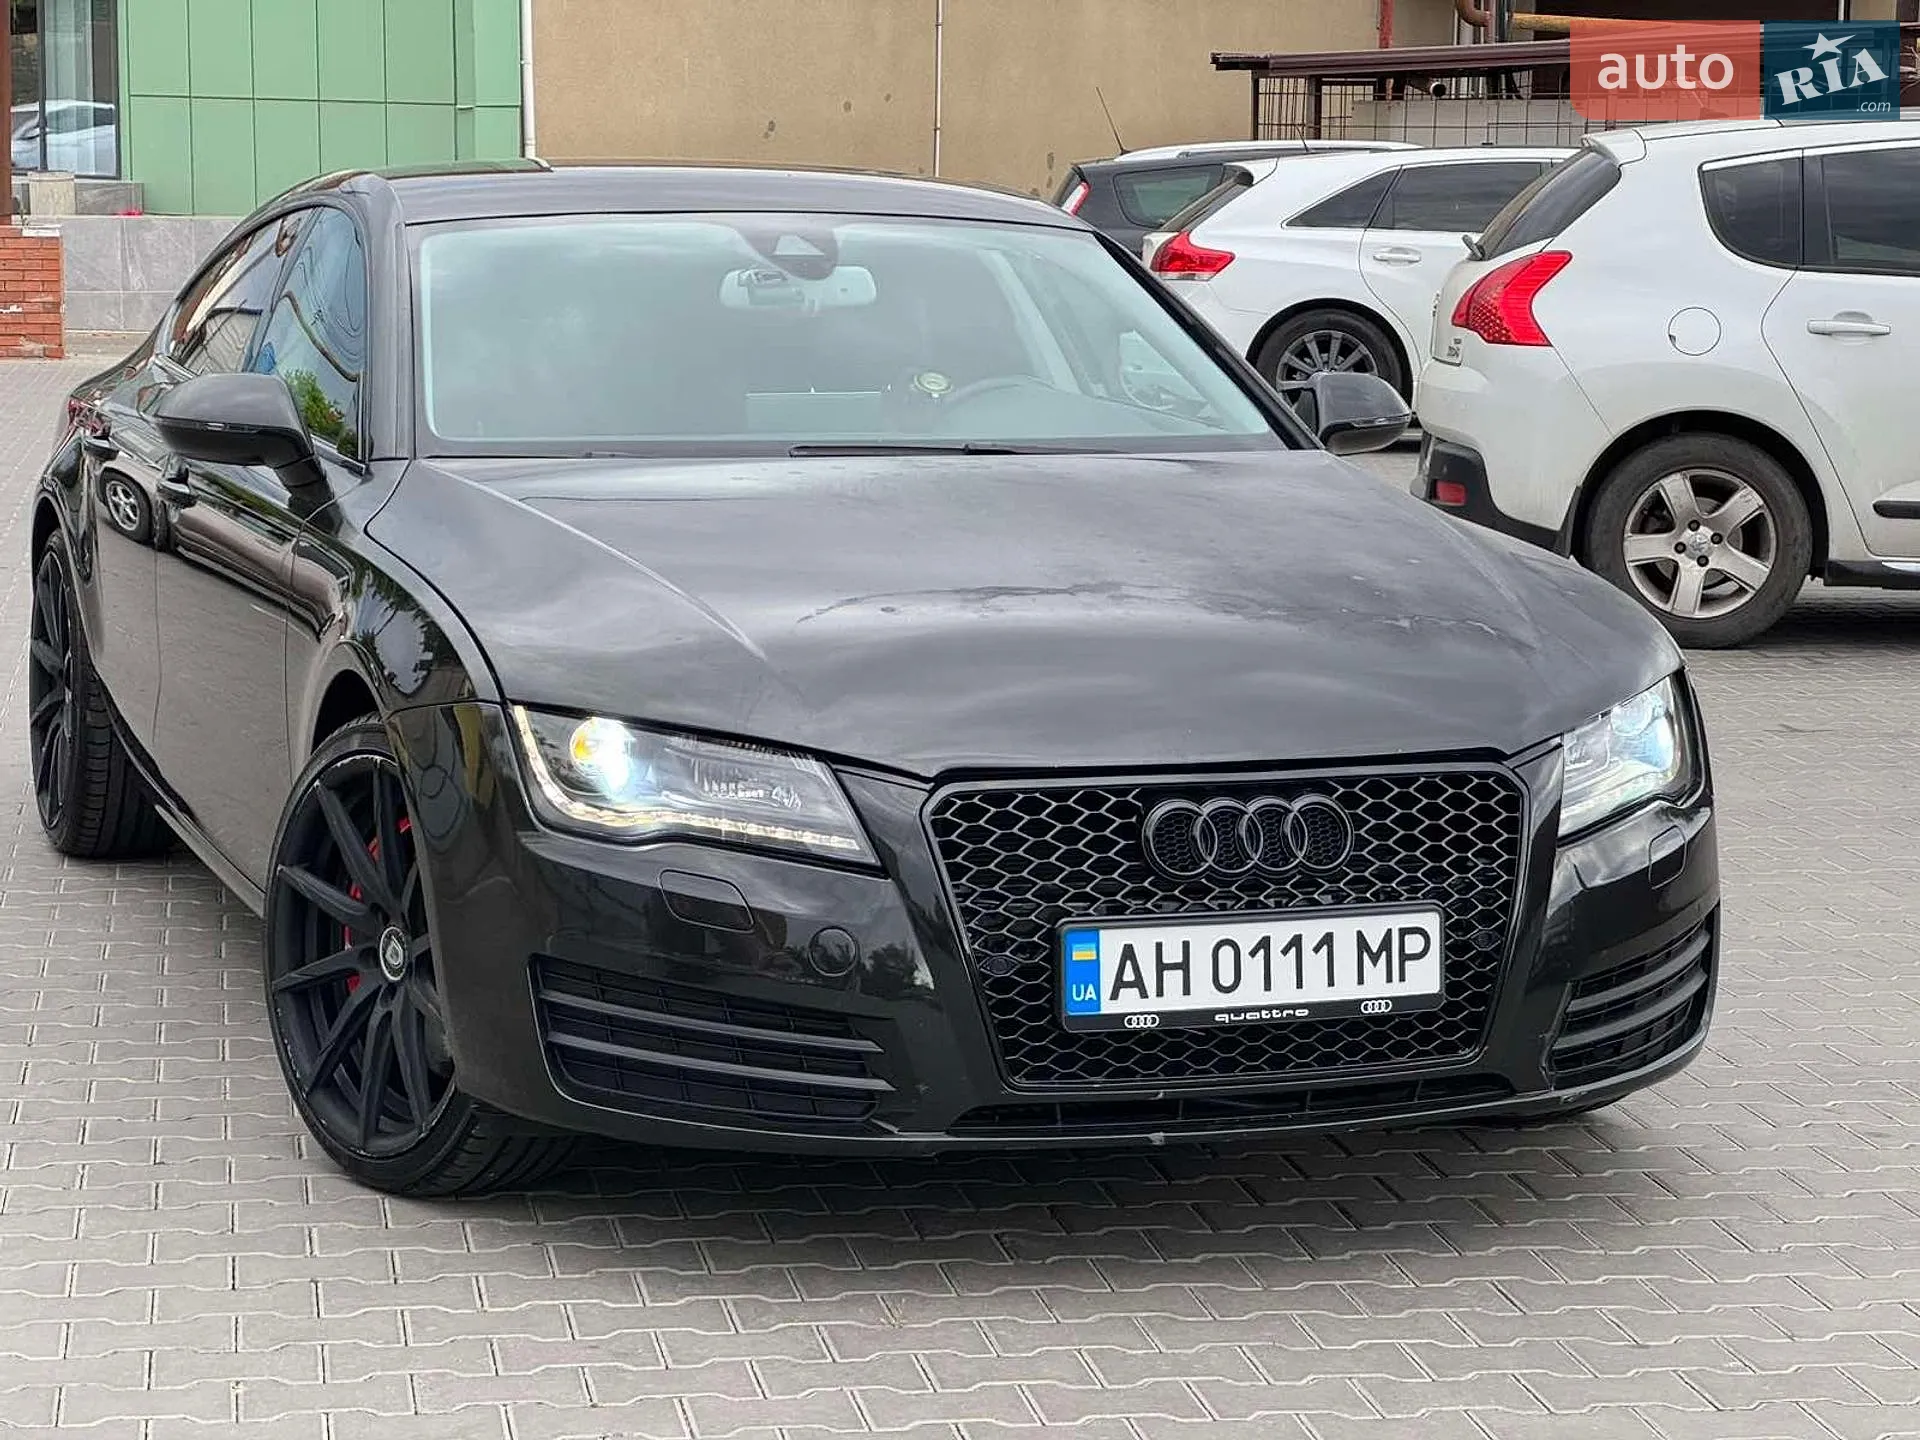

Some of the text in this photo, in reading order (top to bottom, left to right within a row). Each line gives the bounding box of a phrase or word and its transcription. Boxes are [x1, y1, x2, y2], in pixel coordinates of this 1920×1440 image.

[1109, 926, 1432, 1001] AH 0111 MP
[1072, 984, 1097, 1002] UA
[1214, 1008, 1309, 1024] quattro
